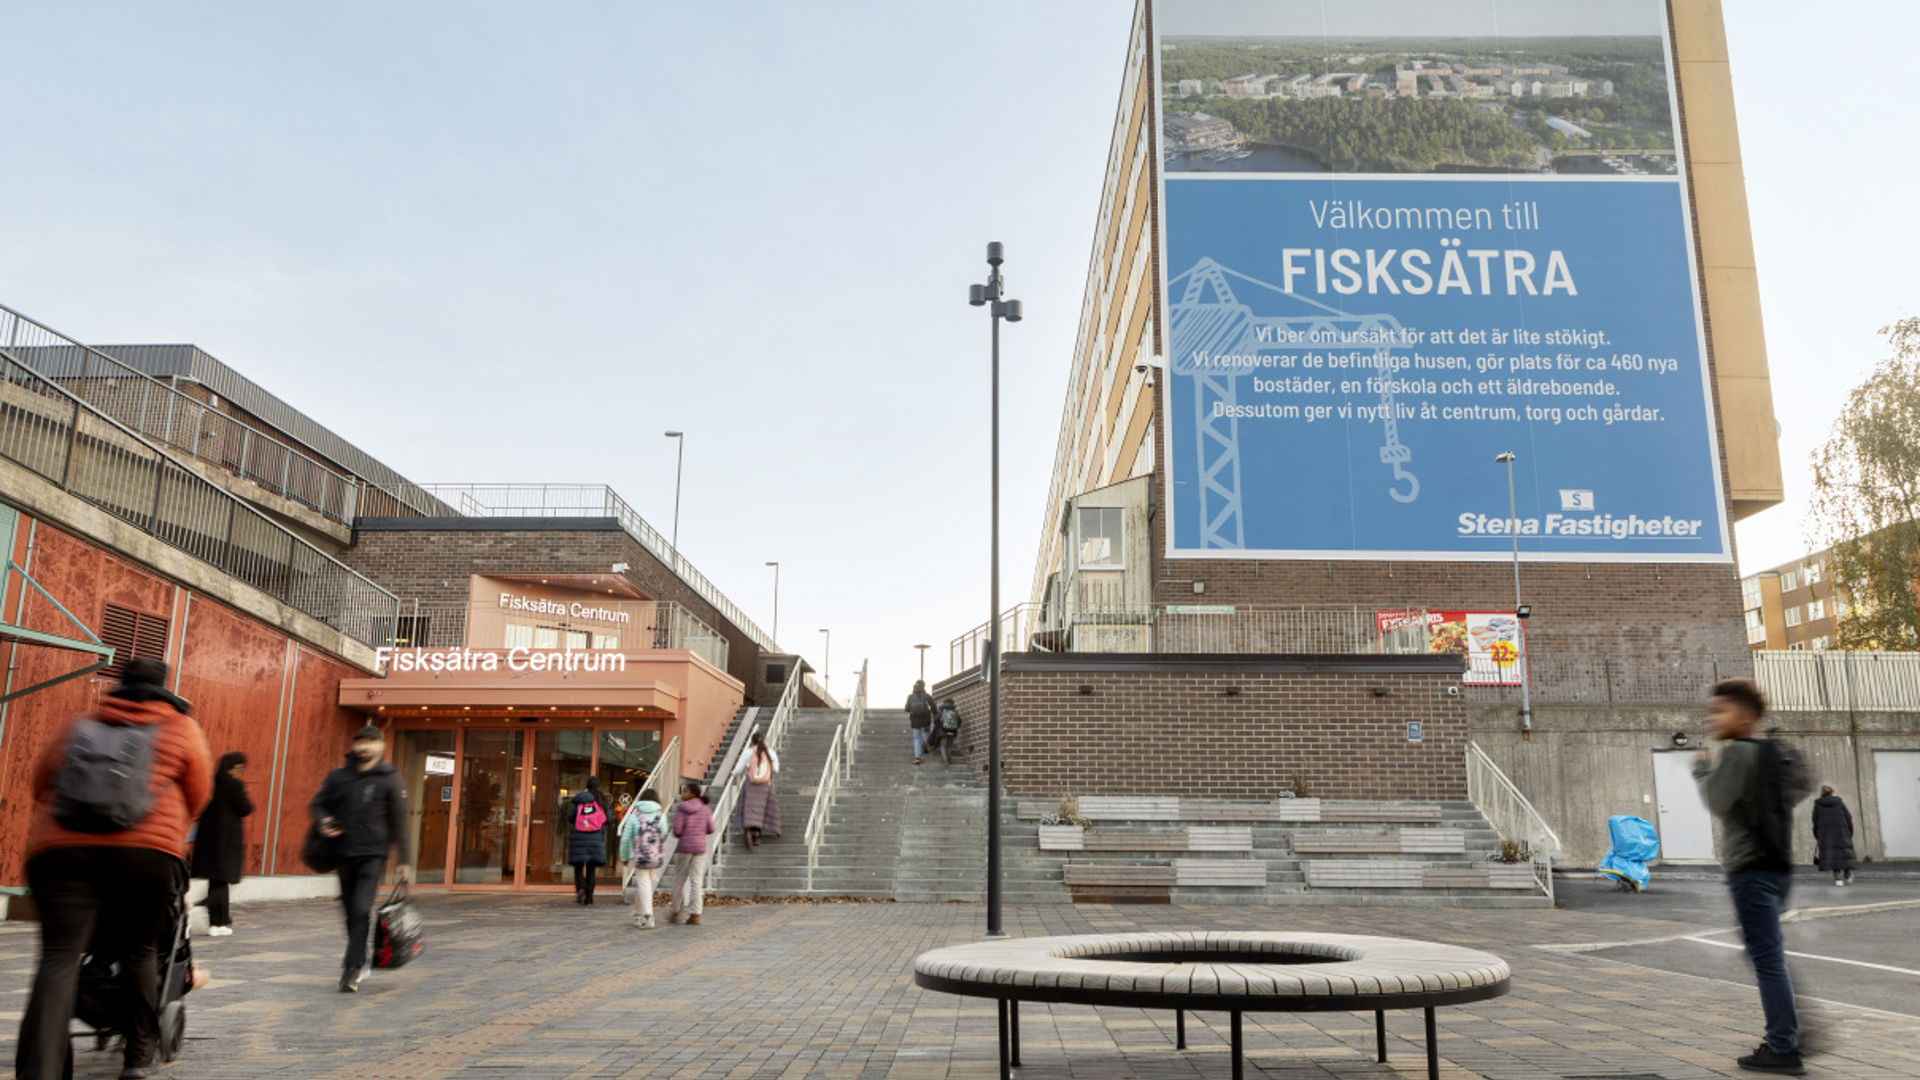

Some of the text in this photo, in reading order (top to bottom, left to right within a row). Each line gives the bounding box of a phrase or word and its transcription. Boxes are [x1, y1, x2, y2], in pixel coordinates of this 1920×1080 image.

[1309, 200, 1539, 230] Välkommen till
[1282, 238, 1578, 296] FISKSÄTRA
[1256, 326, 1611, 349] Vi ber om ursäkt för att det är lite stökigt.
[1193, 351, 1679, 375] Vi renoverar de befintliga husen, gör plats för ca 460 nya
[1254, 377, 1621, 395] bostäder, en förskola och ett äldreboende.
[1213, 401, 1665, 425] Dessutom ger vi nytt liv åt centrum, torg och gårdar.
[1571, 493, 1582, 506] S
[1457, 513, 1702, 539] Stena Fastigheter
[499, 593, 630, 624] Fisksätra Centrum
[375, 647, 626, 672] Fisksätra Centrum
